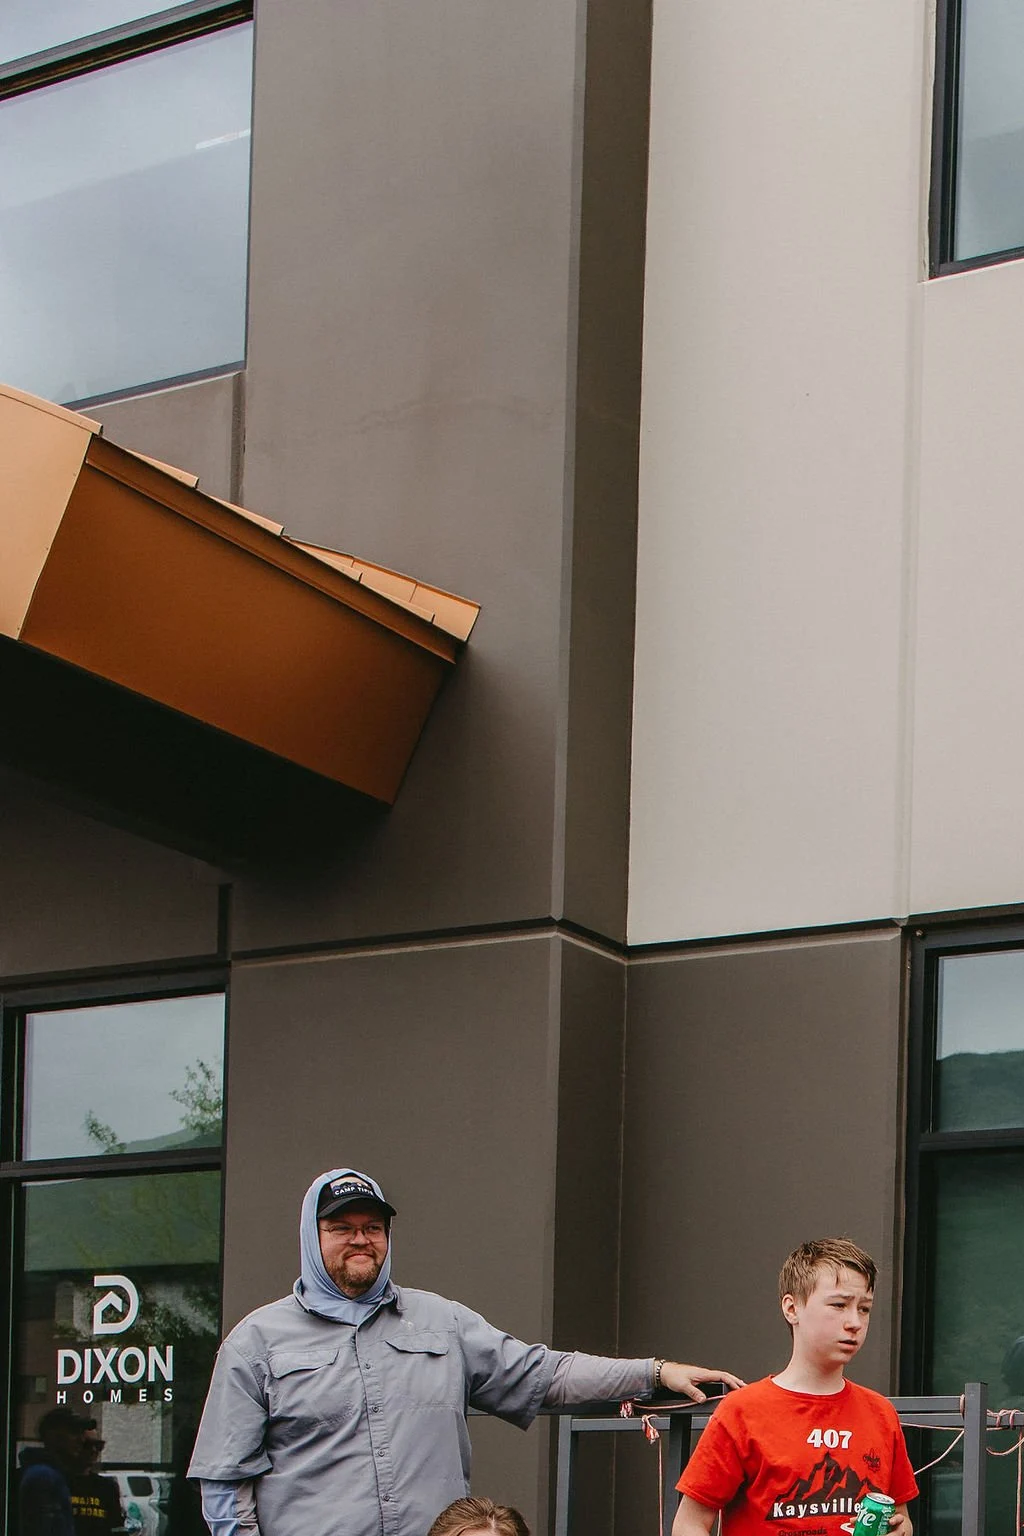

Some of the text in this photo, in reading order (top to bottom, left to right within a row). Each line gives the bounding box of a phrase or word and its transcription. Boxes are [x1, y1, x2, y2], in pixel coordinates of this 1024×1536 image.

[335, 1186, 355, 1195] CAMP
[57, 1345, 174, 1385] DIXON
[56, 1388, 173, 1404] HOMES
[806, 1429, 853, 1449] 407
[773, 1497, 864, 1518] Kaysville
[778, 1528, 828, 1536] Crossroads
